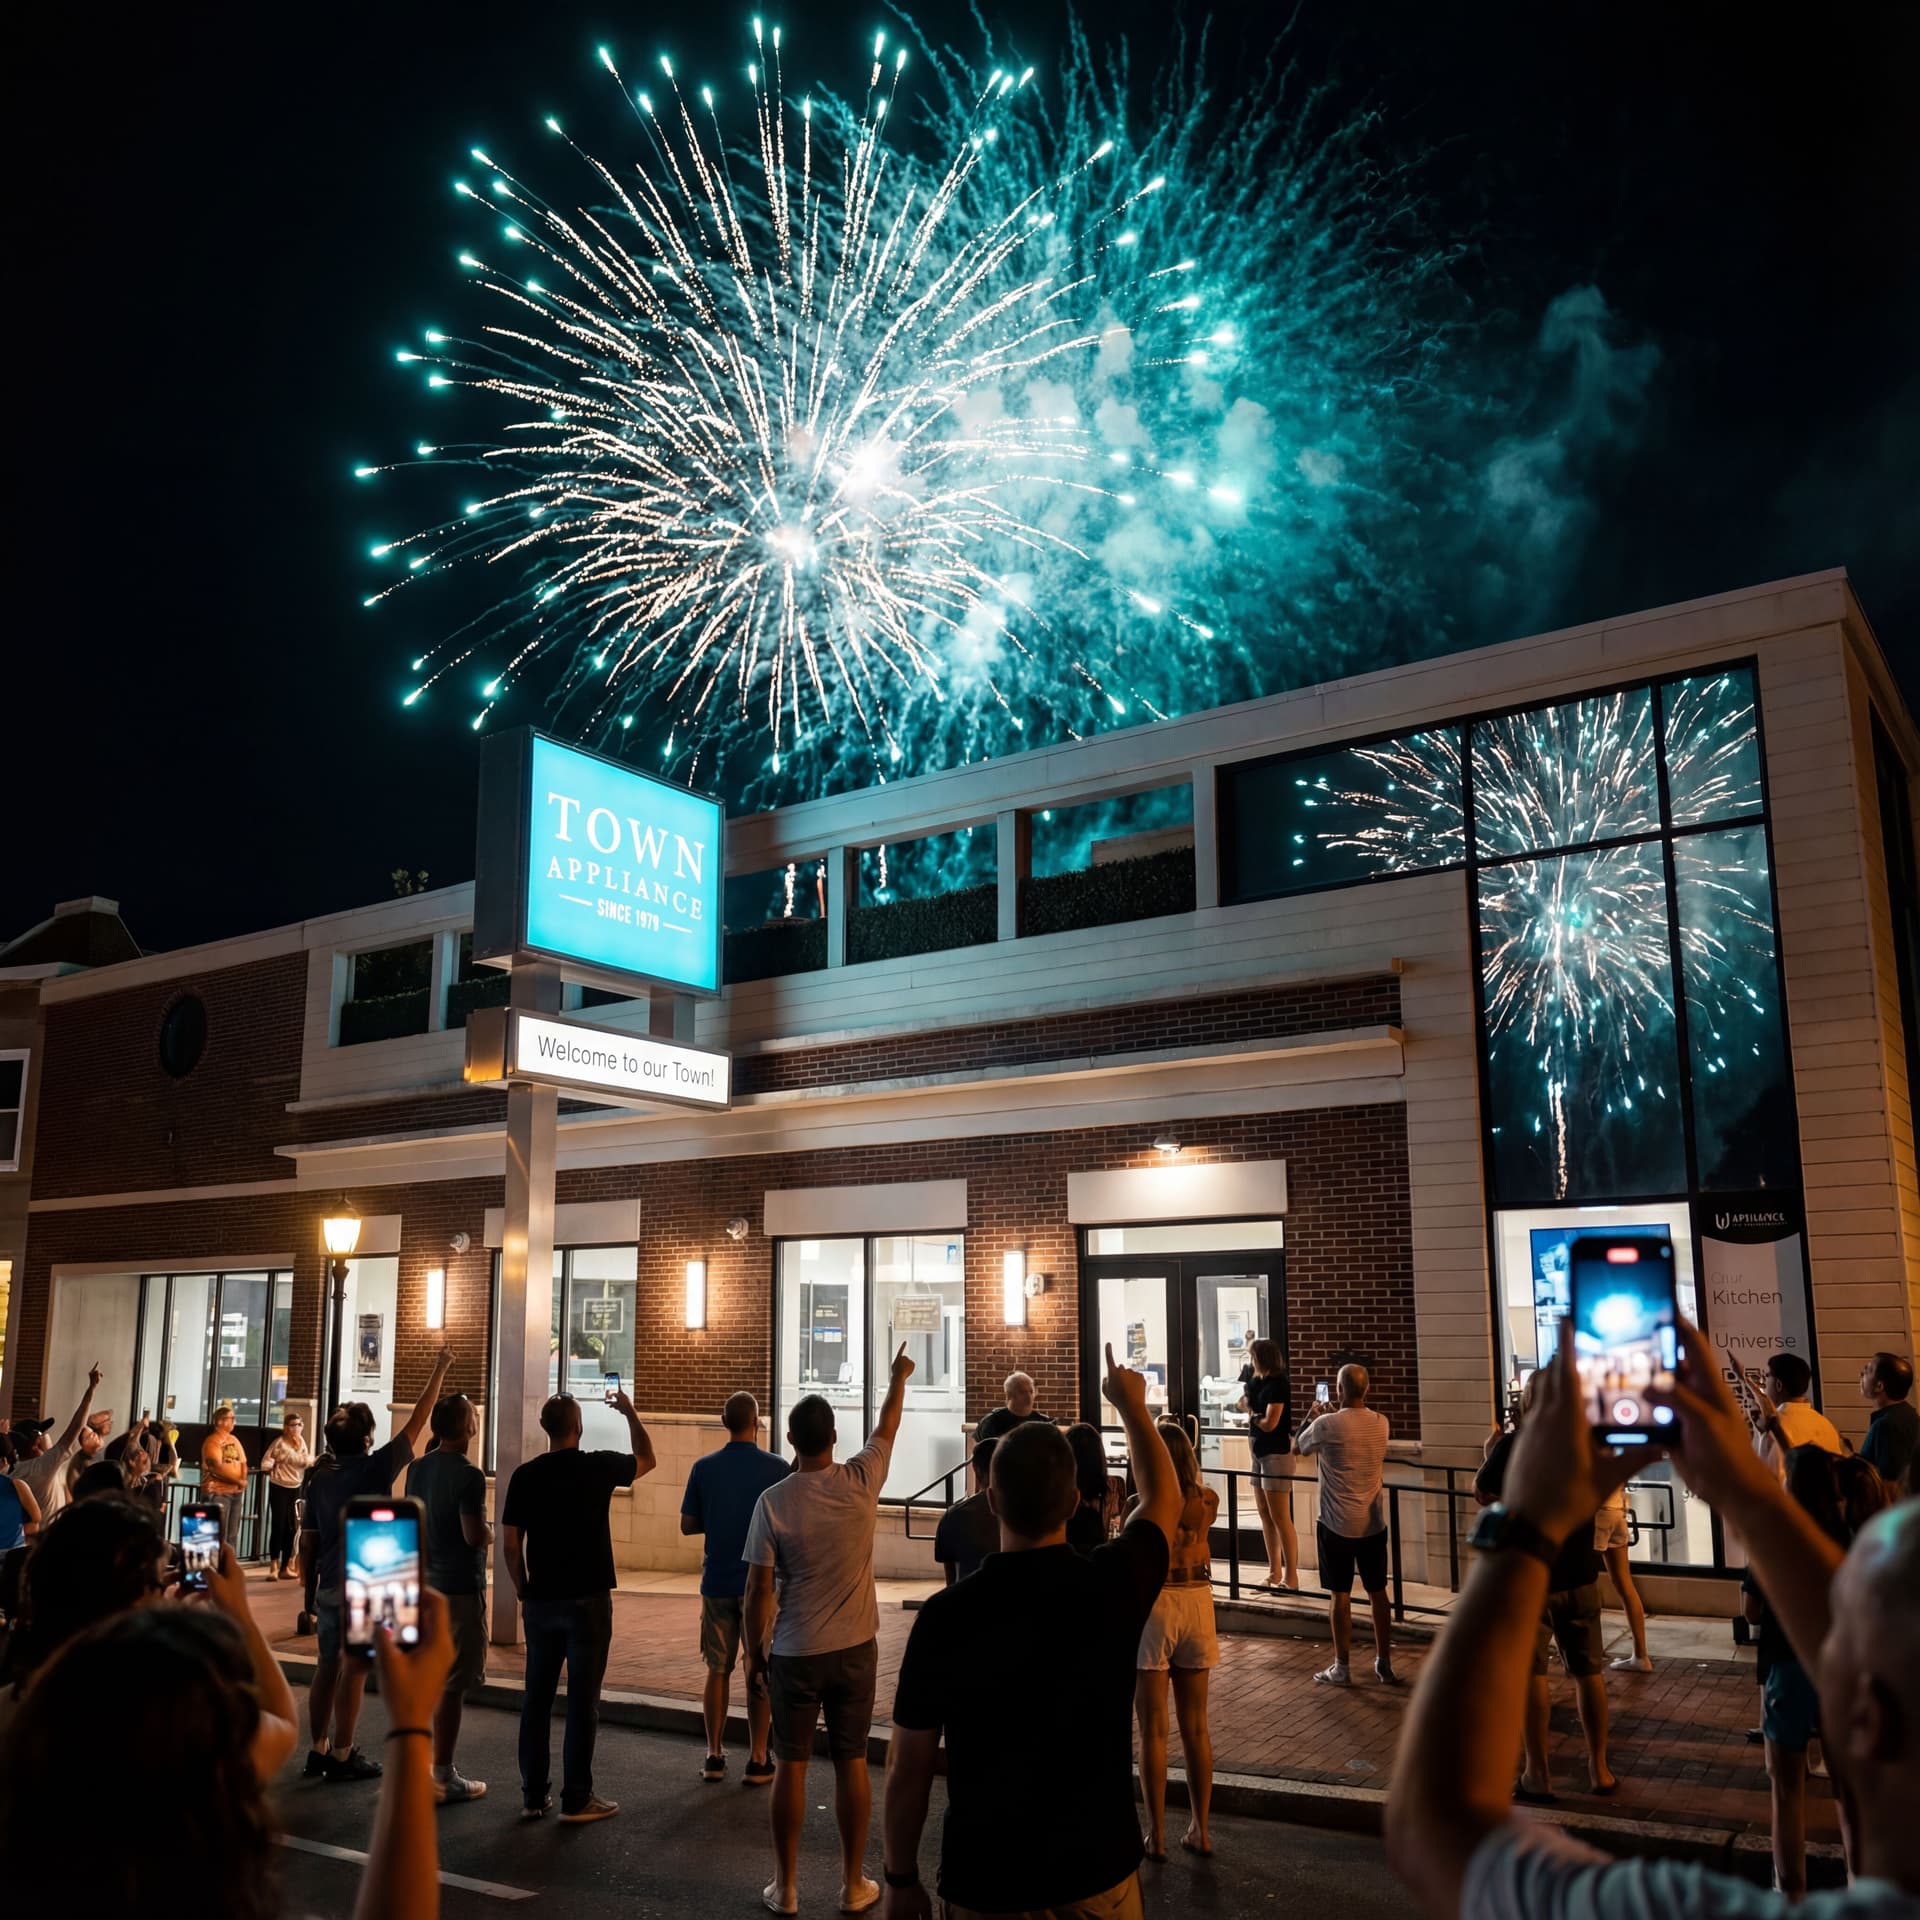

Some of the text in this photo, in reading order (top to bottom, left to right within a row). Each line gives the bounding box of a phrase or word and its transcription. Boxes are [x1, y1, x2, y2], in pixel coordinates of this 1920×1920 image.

[548, 791, 705, 885] TOWN
[546, 855, 703, 921] APPLIANCE
[597, 898, 660, 932] SINCE 1979
[538, 1034, 715, 1088] Welcome to our Town!
[1713, 1288, 1783, 1305] Kitchen
[1715, 1332, 1796, 1349] Universe
